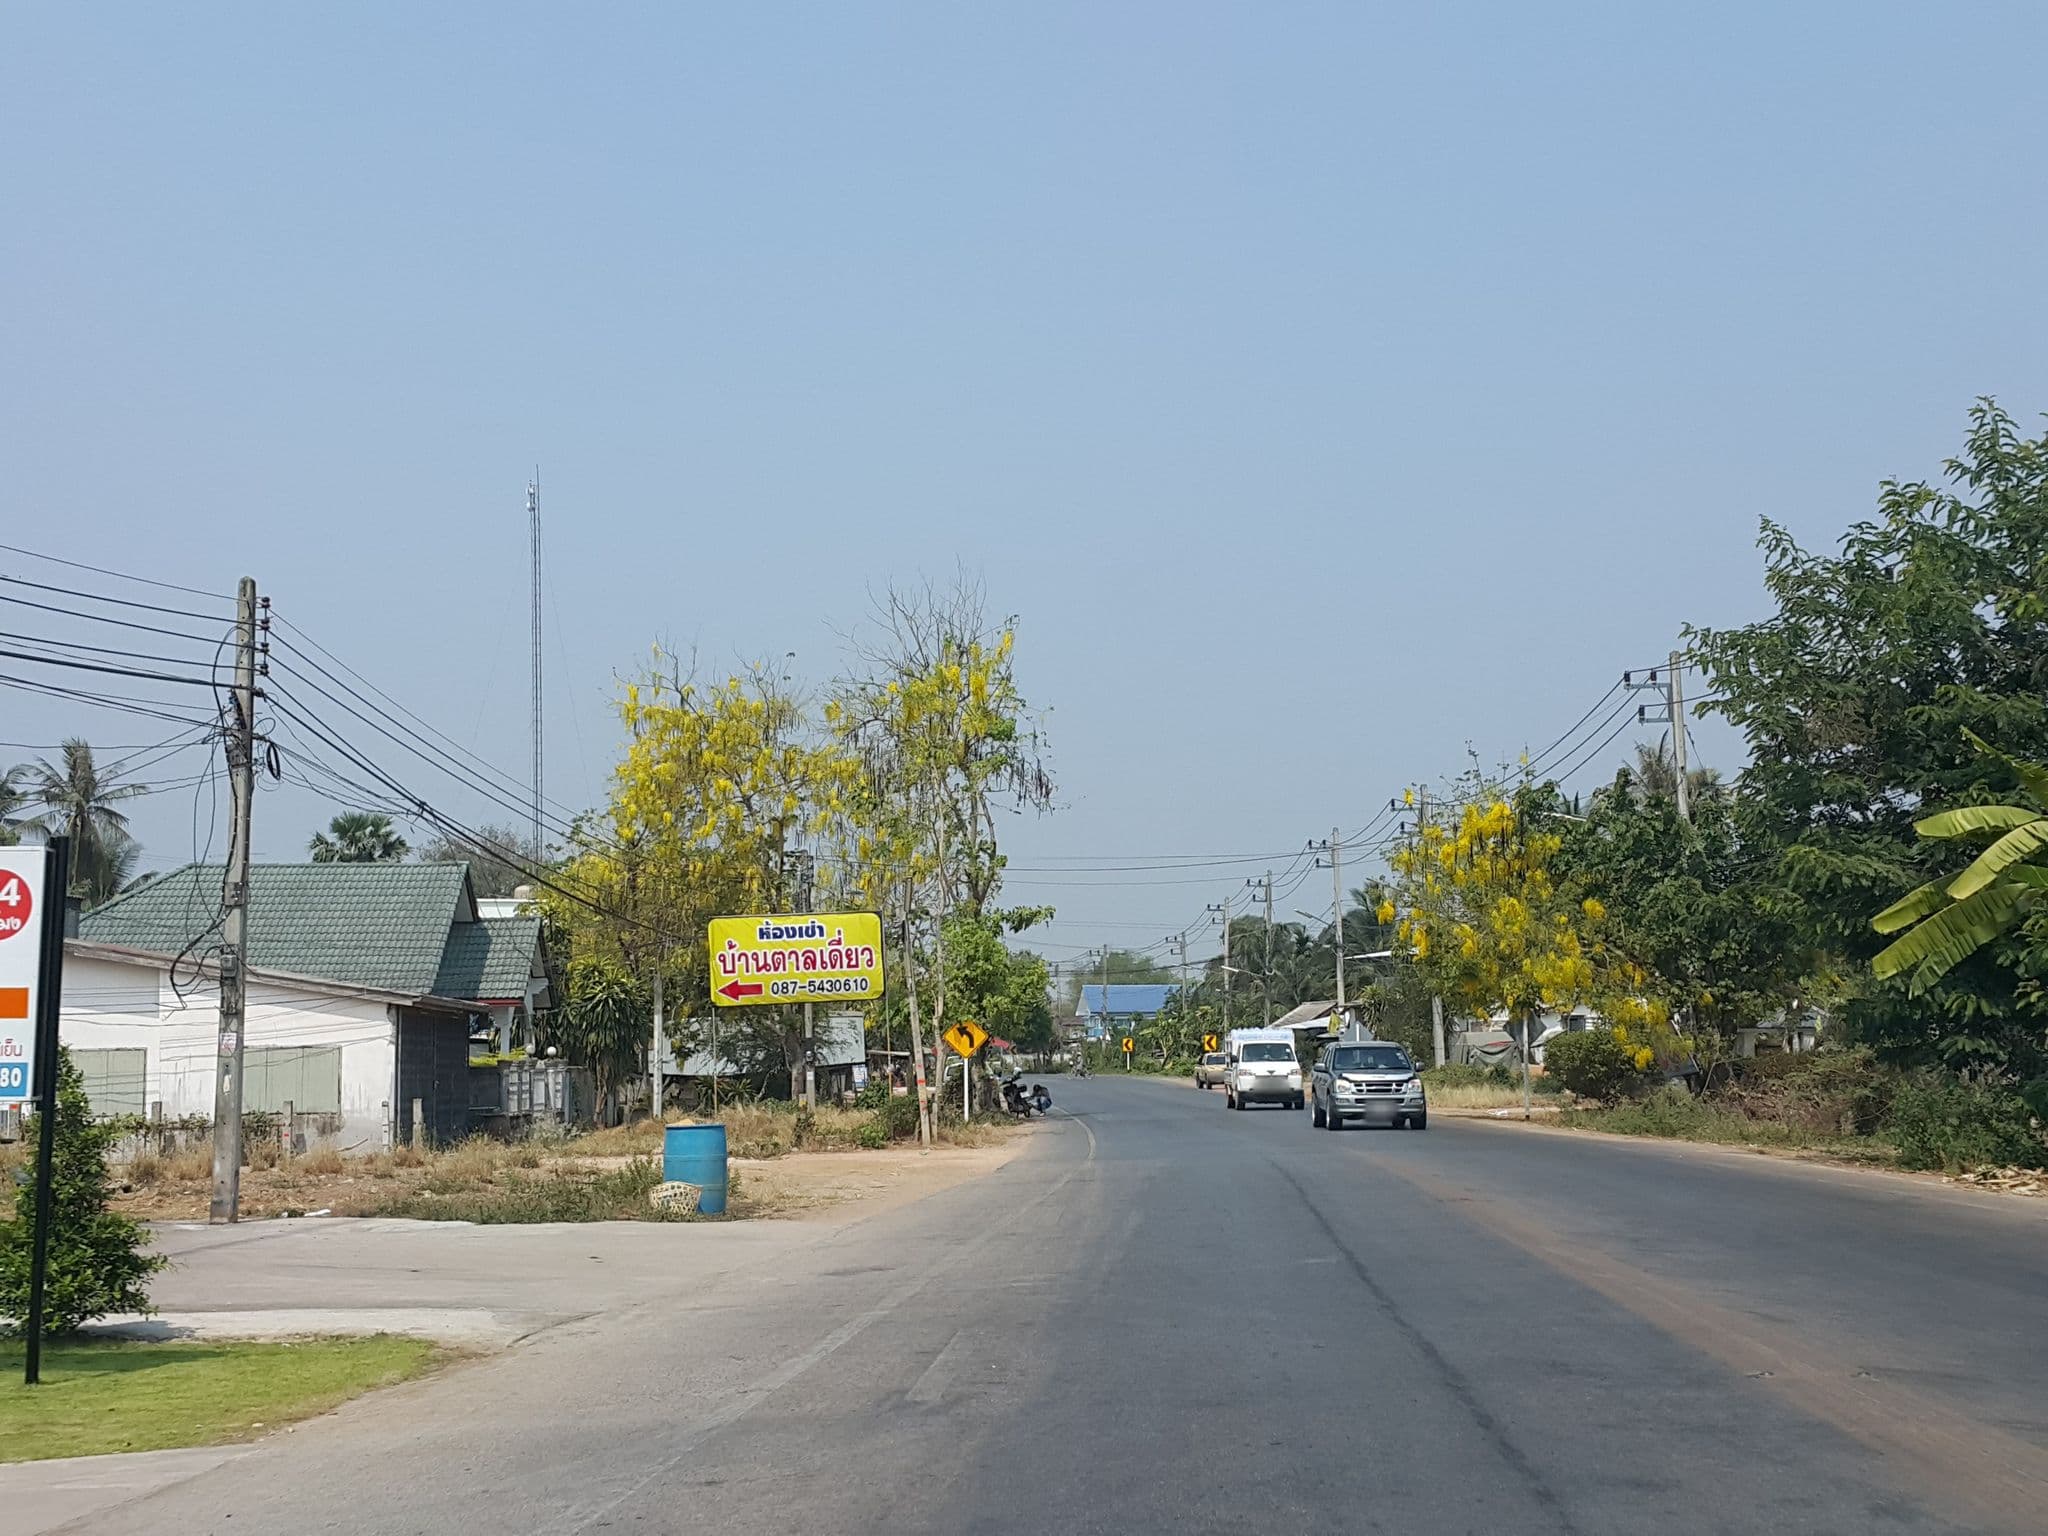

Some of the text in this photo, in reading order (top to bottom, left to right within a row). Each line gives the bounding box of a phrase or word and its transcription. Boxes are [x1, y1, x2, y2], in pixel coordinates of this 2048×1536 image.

[758, 920, 825, 940] ห้องเช่า
[718, 929, 874, 974] บ้านตาลเดี่ยว
[771, 977, 869, 995] 087-5430610
[0, 1067, 22, 1088] 80
